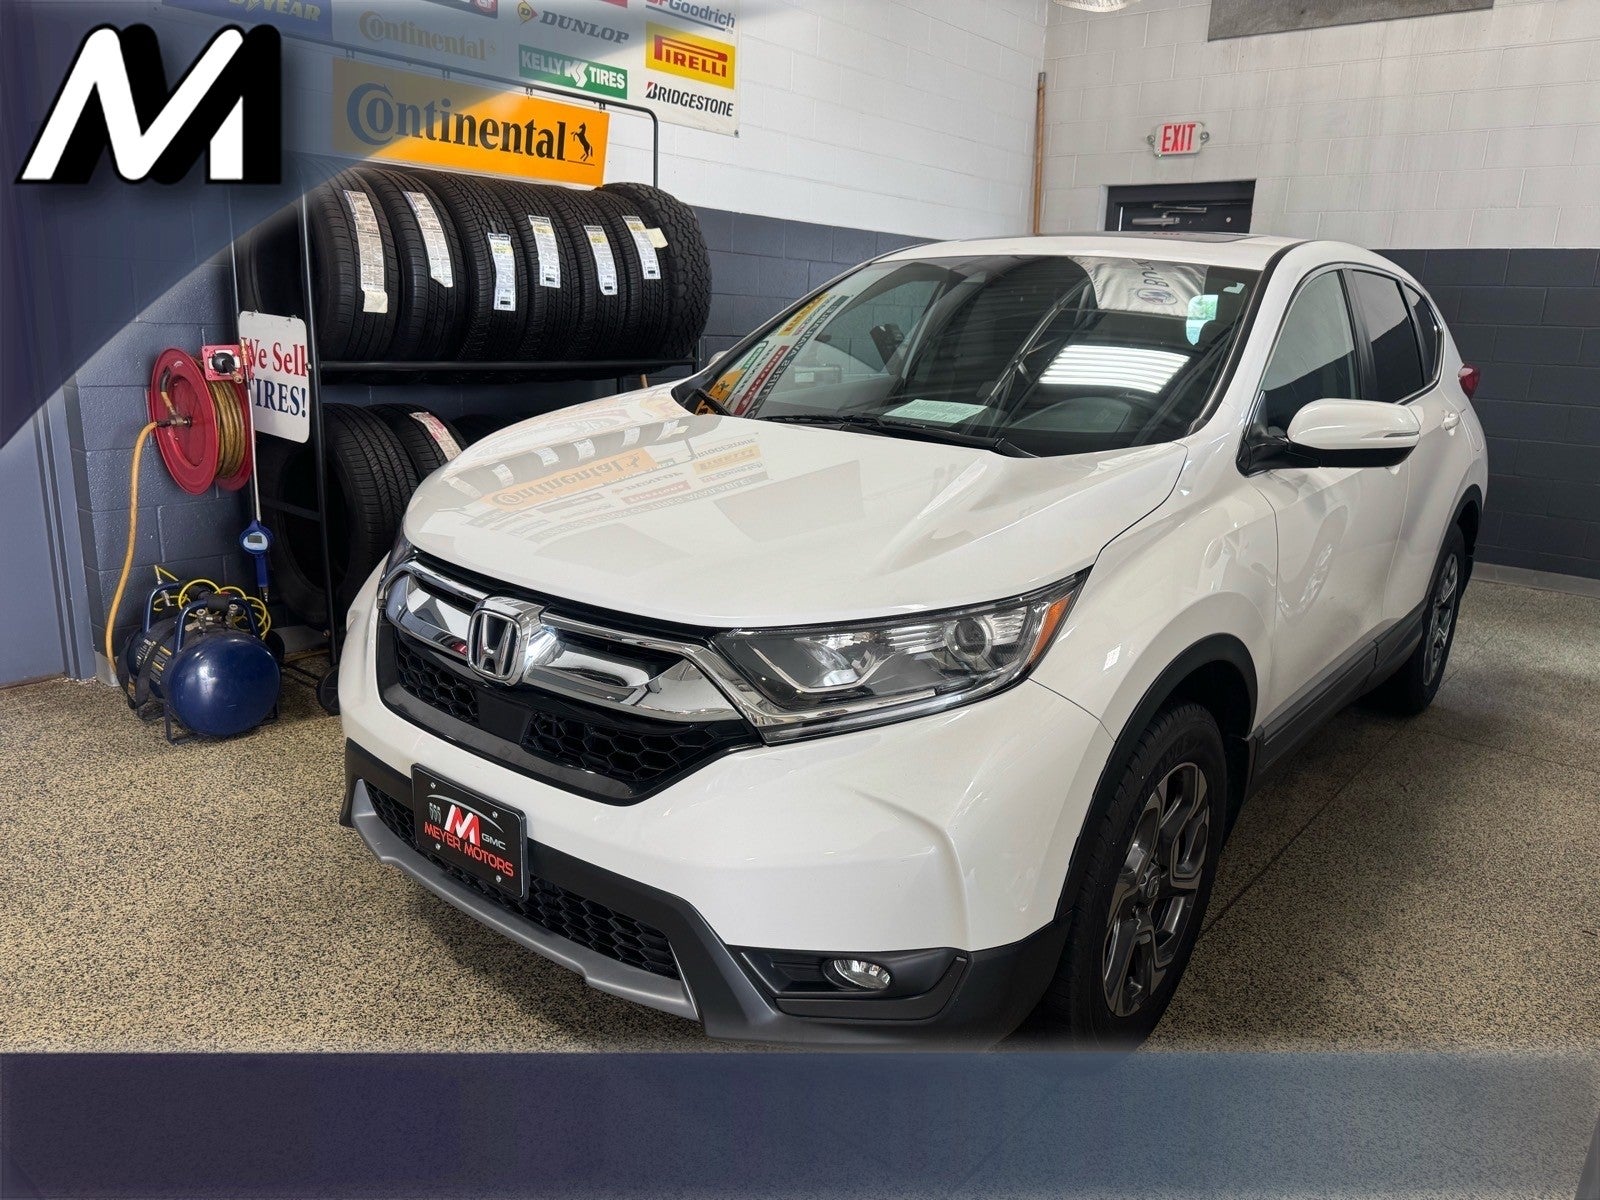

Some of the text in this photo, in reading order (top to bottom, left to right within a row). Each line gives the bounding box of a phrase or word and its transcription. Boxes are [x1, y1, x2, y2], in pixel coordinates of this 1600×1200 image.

[359, 10, 486, 61] Continental
[539, 10, 629, 44] DUNLOP
[521, 51, 563, 75] KELLY
[589, 66, 625, 90] TIRES
[654, 34, 728, 77] PIRELLI
[645, 81, 734, 117] BRIDGESTONE
[346, 82, 566, 161] Continental
[1161, 124, 1196, 152] EXIT
[272, 341, 307, 377] Sell
[251, 377, 306, 418] IRES!
[424, 822, 514, 878] MEYER MOTORS
[481, 832, 506, 851] GMC
